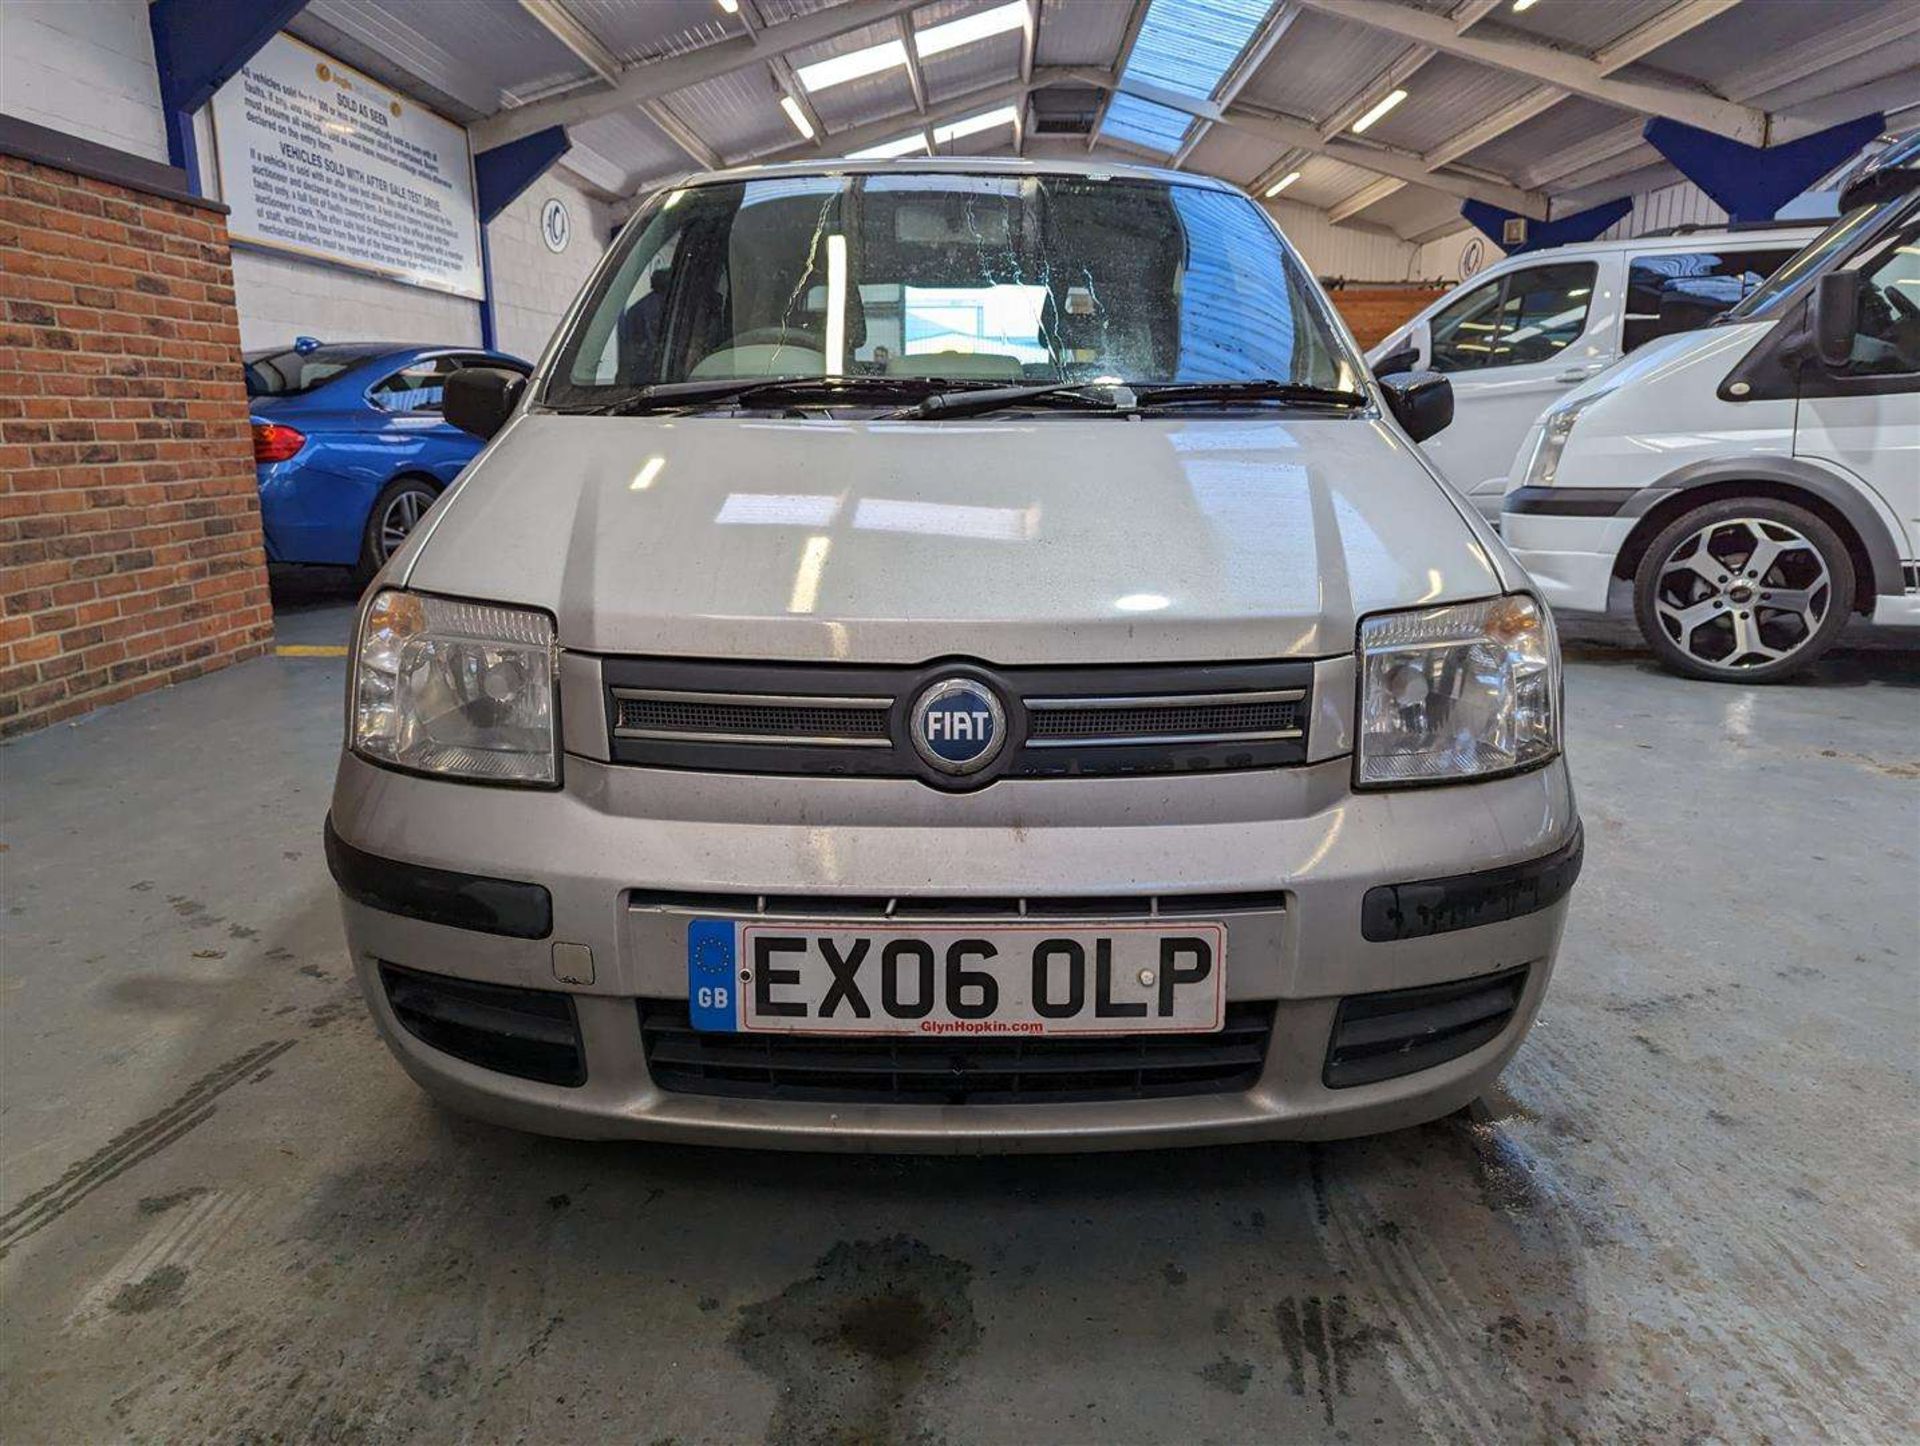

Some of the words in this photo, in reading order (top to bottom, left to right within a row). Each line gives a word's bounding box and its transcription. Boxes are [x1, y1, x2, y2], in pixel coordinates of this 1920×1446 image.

[336, 91, 357, 113] SOLD
[358, 102, 368, 118] AS
[369, 107, 387, 127] SEEN
[279, 140, 322, 169] VEHICLES
[323, 157, 344, 176] SOLD
[346, 165, 365, 184] WITH
[366, 173, 387, 193] AFTER
[389, 182, 405, 199] SALE
[407, 188, 422, 205] TEST
[928, 711, 988, 740] FIAT
[754, 937, 999, 1019] EX06
[1032, 937, 1212, 1018] OLP
[698, 987, 729, 1009] GB
[920, 1021, 1043, 1034] GlynHopkin.com
